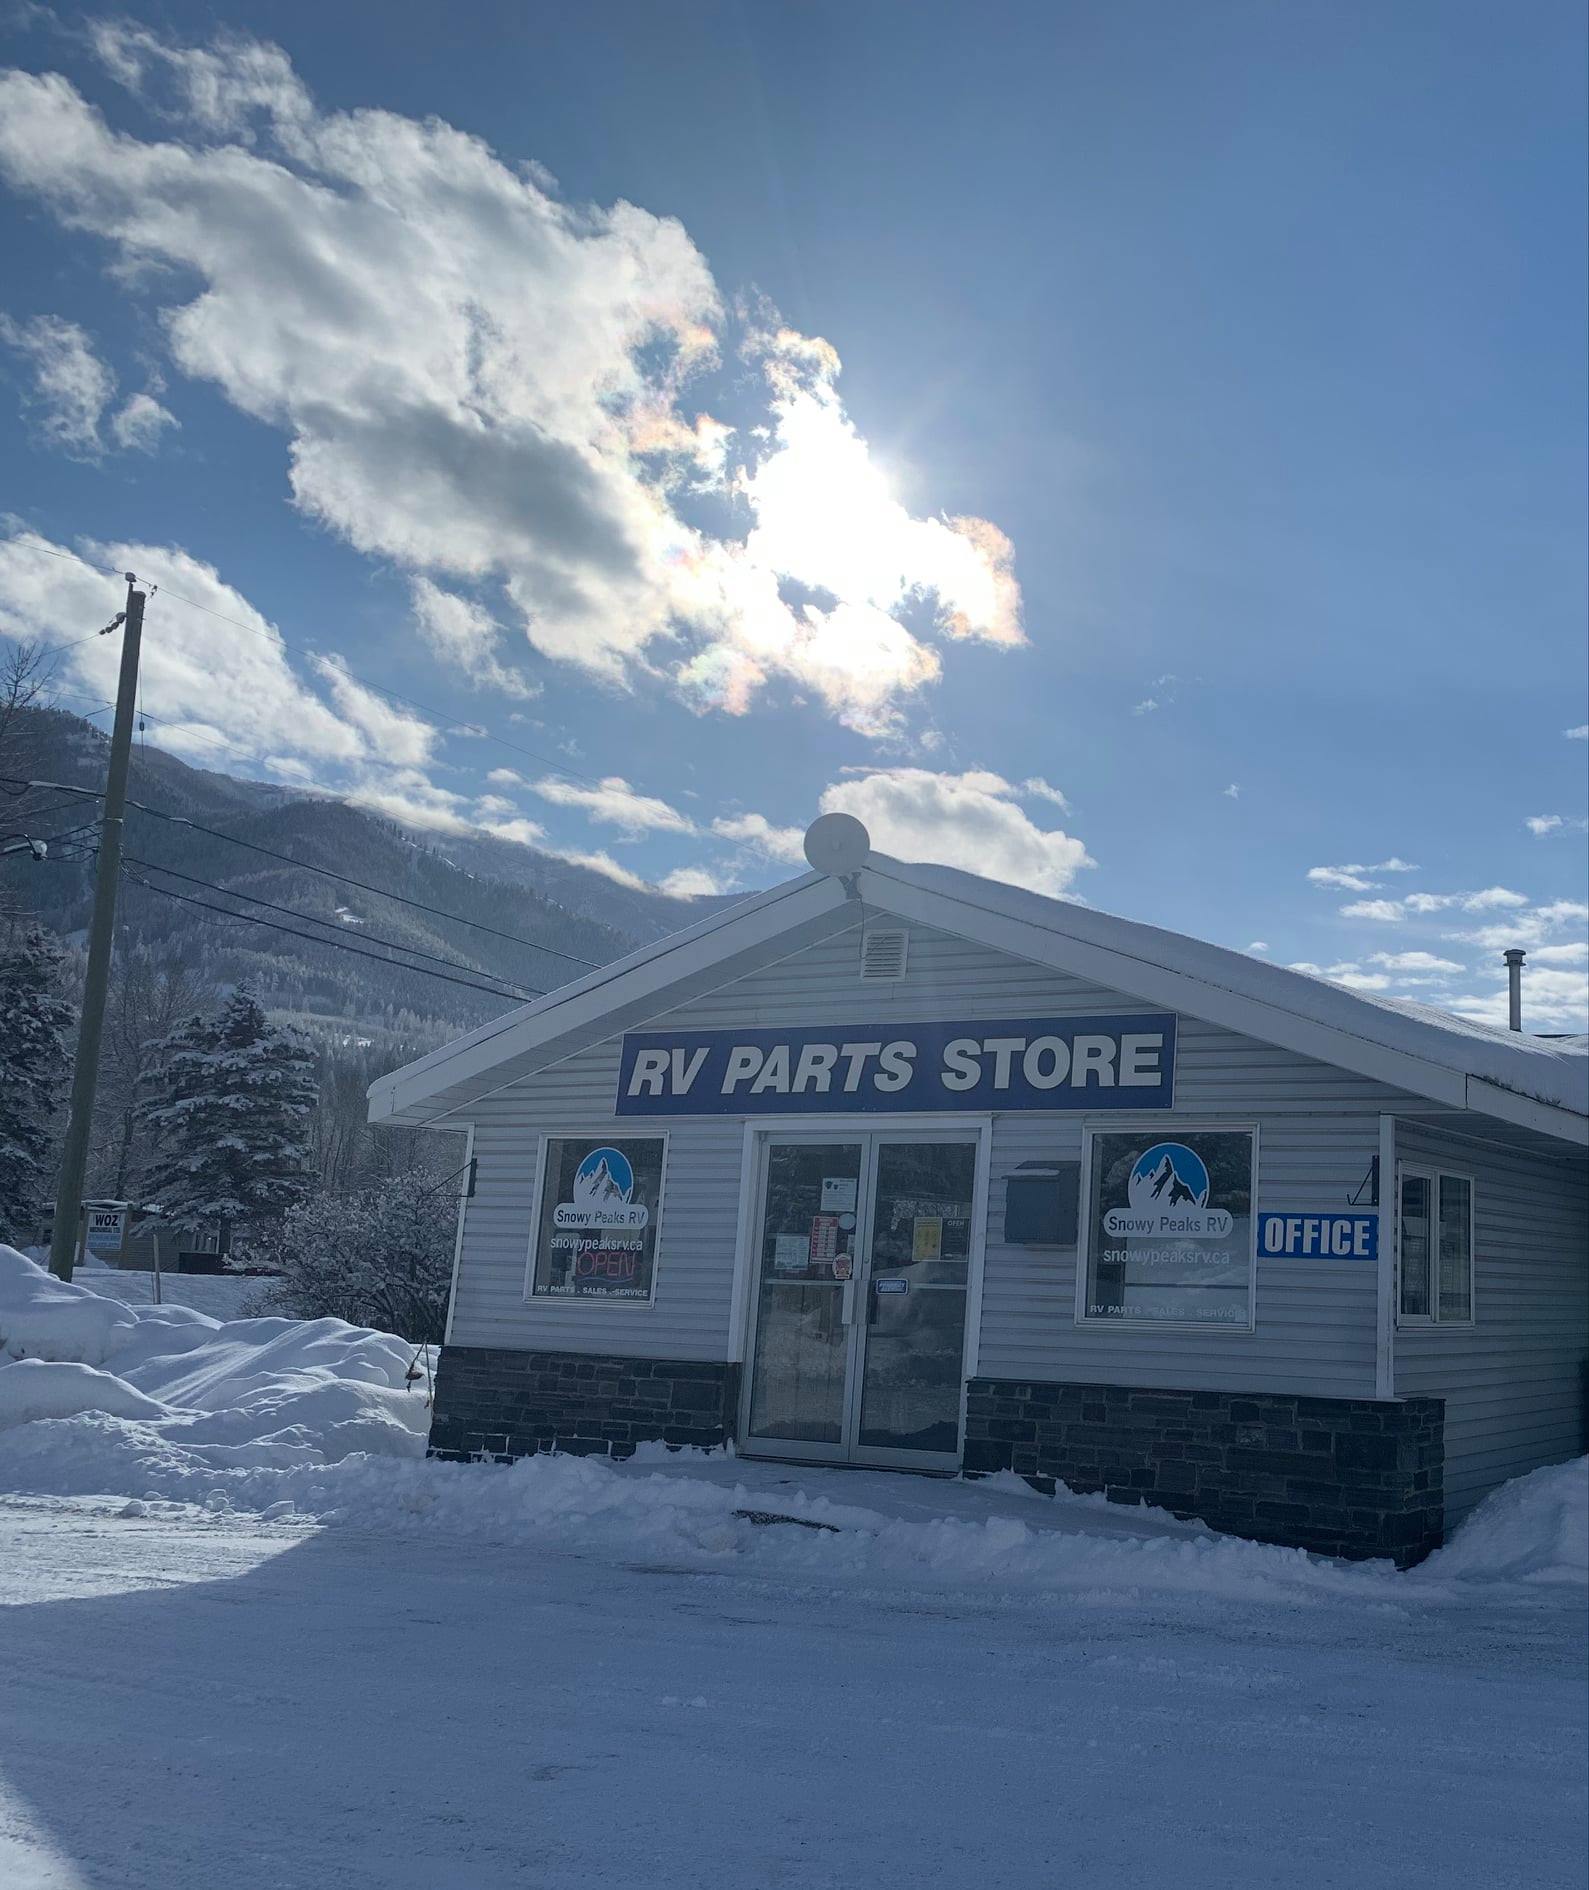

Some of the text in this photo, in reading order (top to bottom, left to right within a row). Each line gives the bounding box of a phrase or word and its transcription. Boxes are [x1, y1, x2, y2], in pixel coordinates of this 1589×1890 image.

[627, 1033, 1164, 1096] RV PARTS STORE
[95, 1214, 118, 1226] WOZ
[557, 1209, 645, 1225] Snowy Peaks RV
[1108, 1216, 1228, 1233] Snowy Peaks RV
[550, 1236, 643, 1252] snowypeaksrv.ca
[1264, 1217, 1370, 1255] OFFICE
[577, 1251, 636, 1276] OPEN
[1103, 1248, 1230, 1266] snowypeaksrv.ca
[582, 1287, 607, 1295] SALES
[1090, 1305, 1104, 1313] RV
[1107, 1305, 1142, 1315] PARTS
